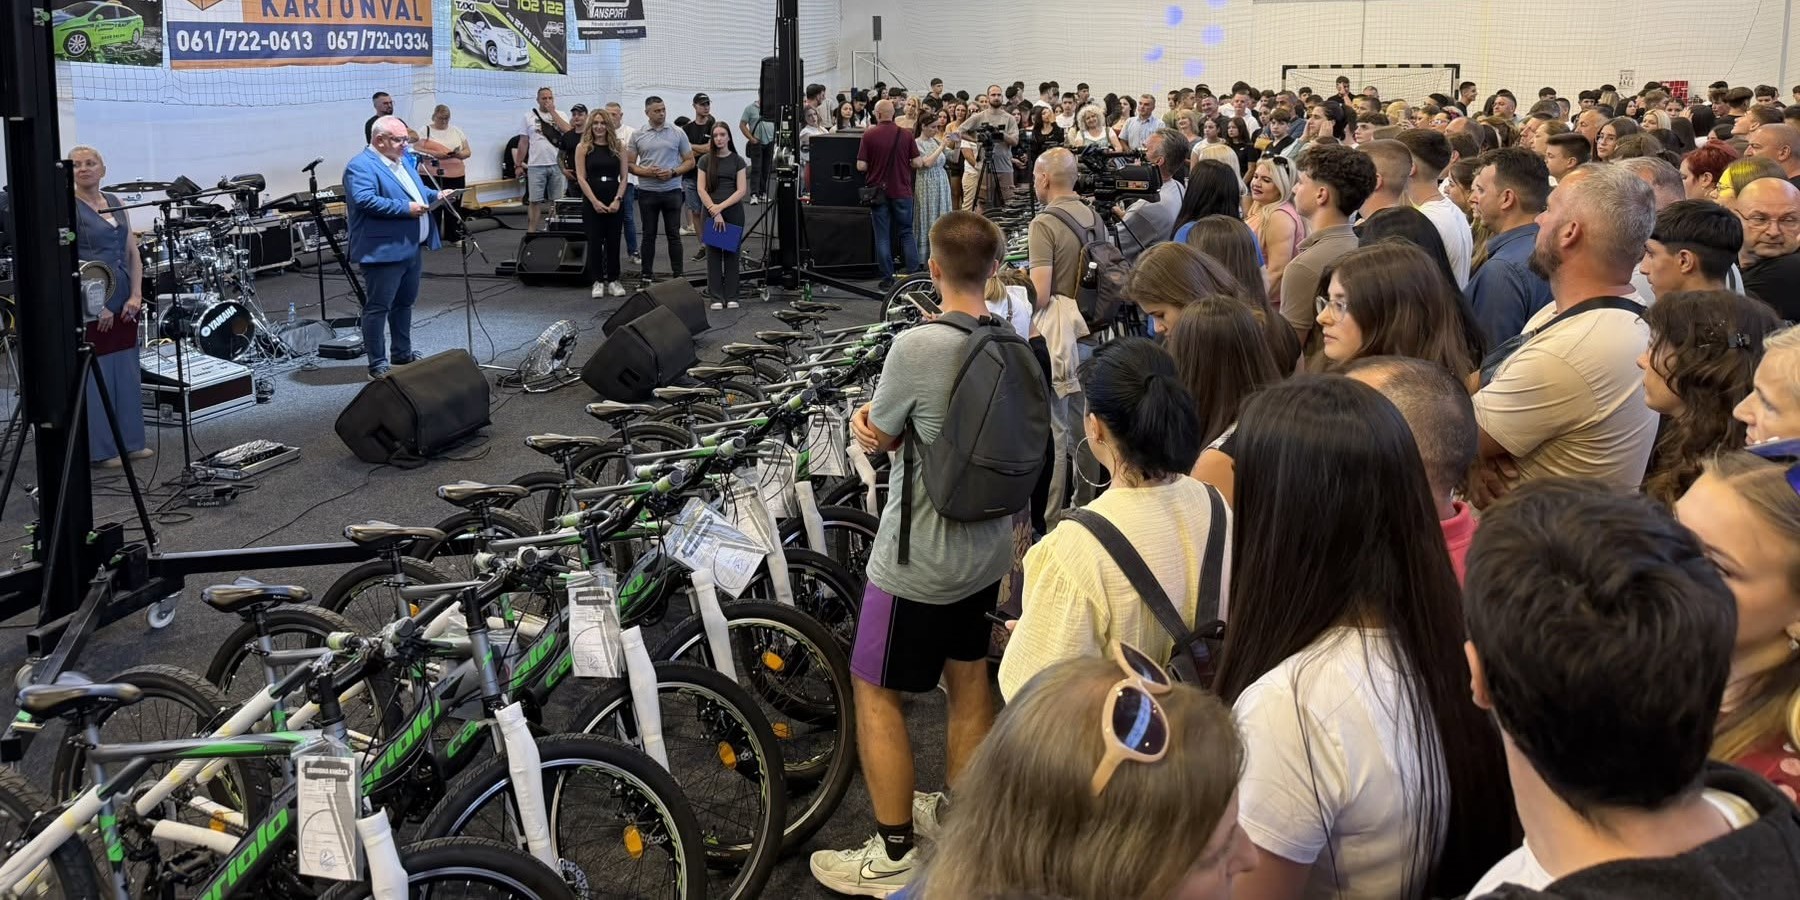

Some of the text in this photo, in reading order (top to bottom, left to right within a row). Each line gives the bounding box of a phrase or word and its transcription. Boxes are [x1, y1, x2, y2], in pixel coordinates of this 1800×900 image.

[455, 1, 475, 10] TAXI
[542, 1, 564, 15] 122
[176, 28, 429, 53] 061/722-0613 067/722-0334
[208, 305, 237, 330] YAMAHA
